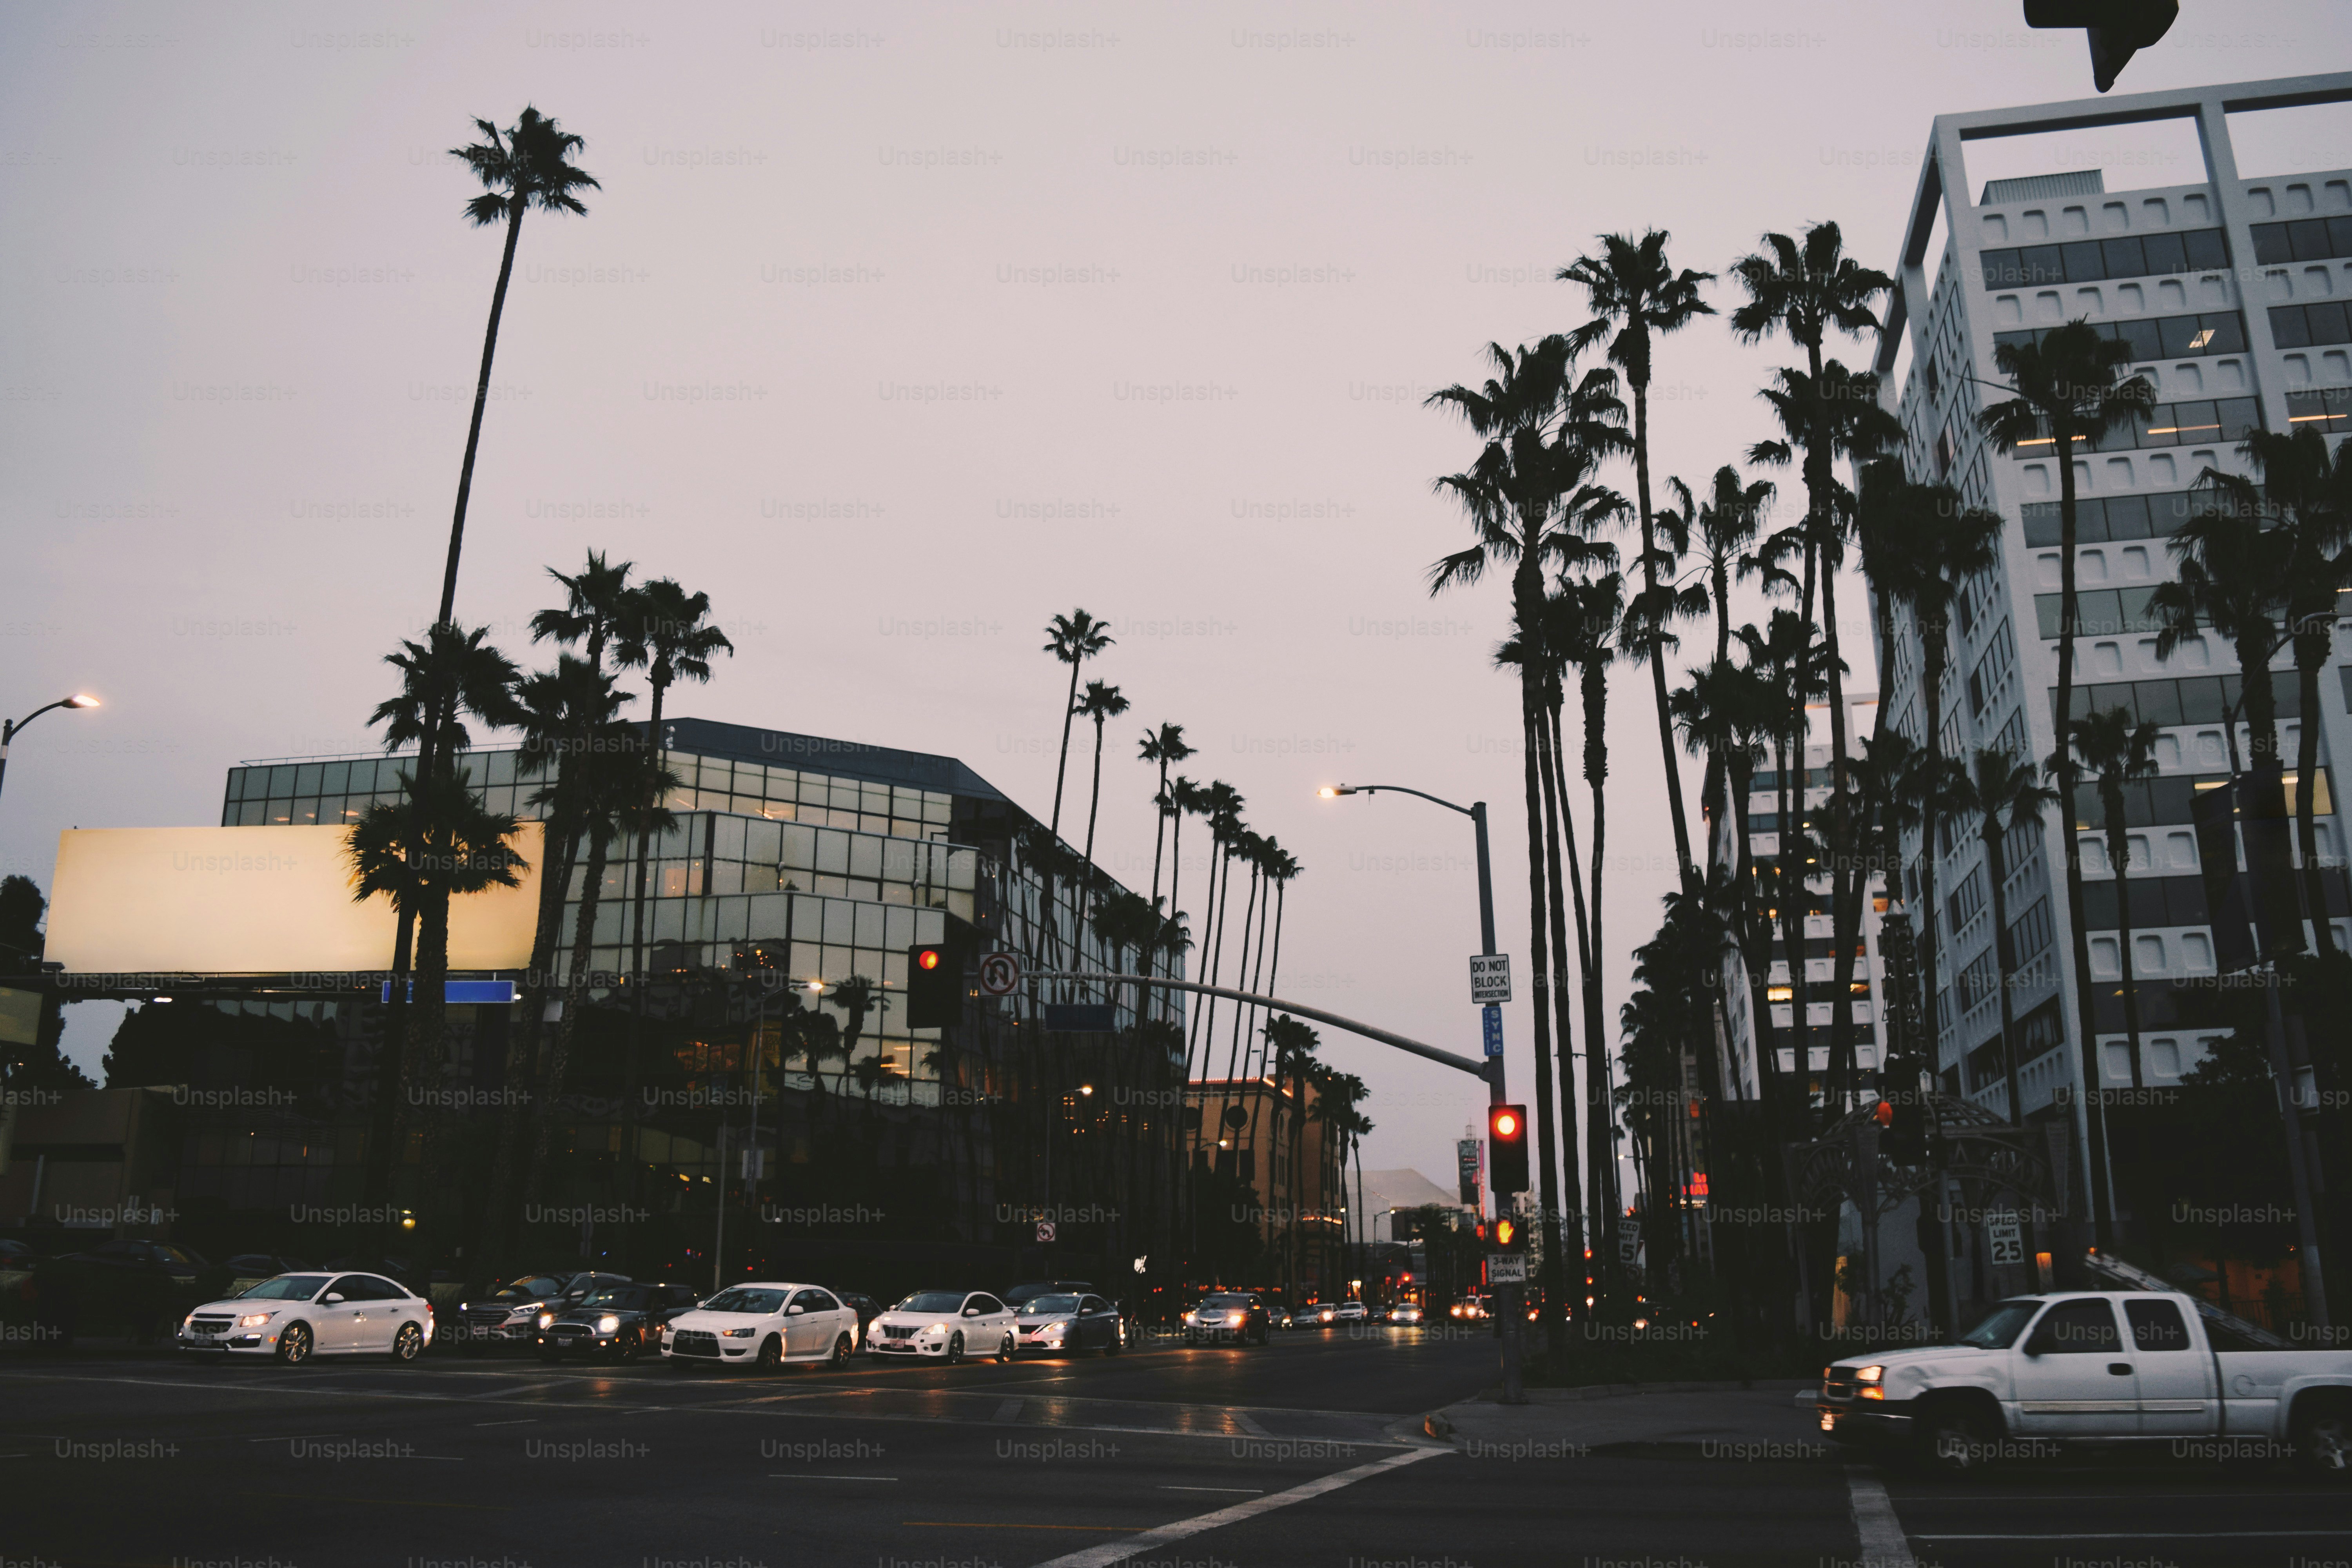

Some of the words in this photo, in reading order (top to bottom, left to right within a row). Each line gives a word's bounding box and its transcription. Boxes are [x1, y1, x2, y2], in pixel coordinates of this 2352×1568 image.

[1473, 961, 1485, 973] DO
[1488, 960, 1506, 971] NOT
[1474, 975, 1506, 988] BLOCK
[1475, 989, 1508, 998] INTERSECTION
[1491, 1010, 1502, 1053] SYNC
[1989, 1216, 2017, 1226] SPEED
[1620, 1222, 1638, 1232] EED
[1619, 1232, 1633, 1241] MIT
[1993, 1229, 2015, 1238] LIMIT
[1620, 1244, 1634, 1261] 5
[1993, 1241, 2022, 1261] 25
[1493, 1256, 1520, 1265] 3-WAY
[1491, 1269, 1523, 1278] SIGNAL
